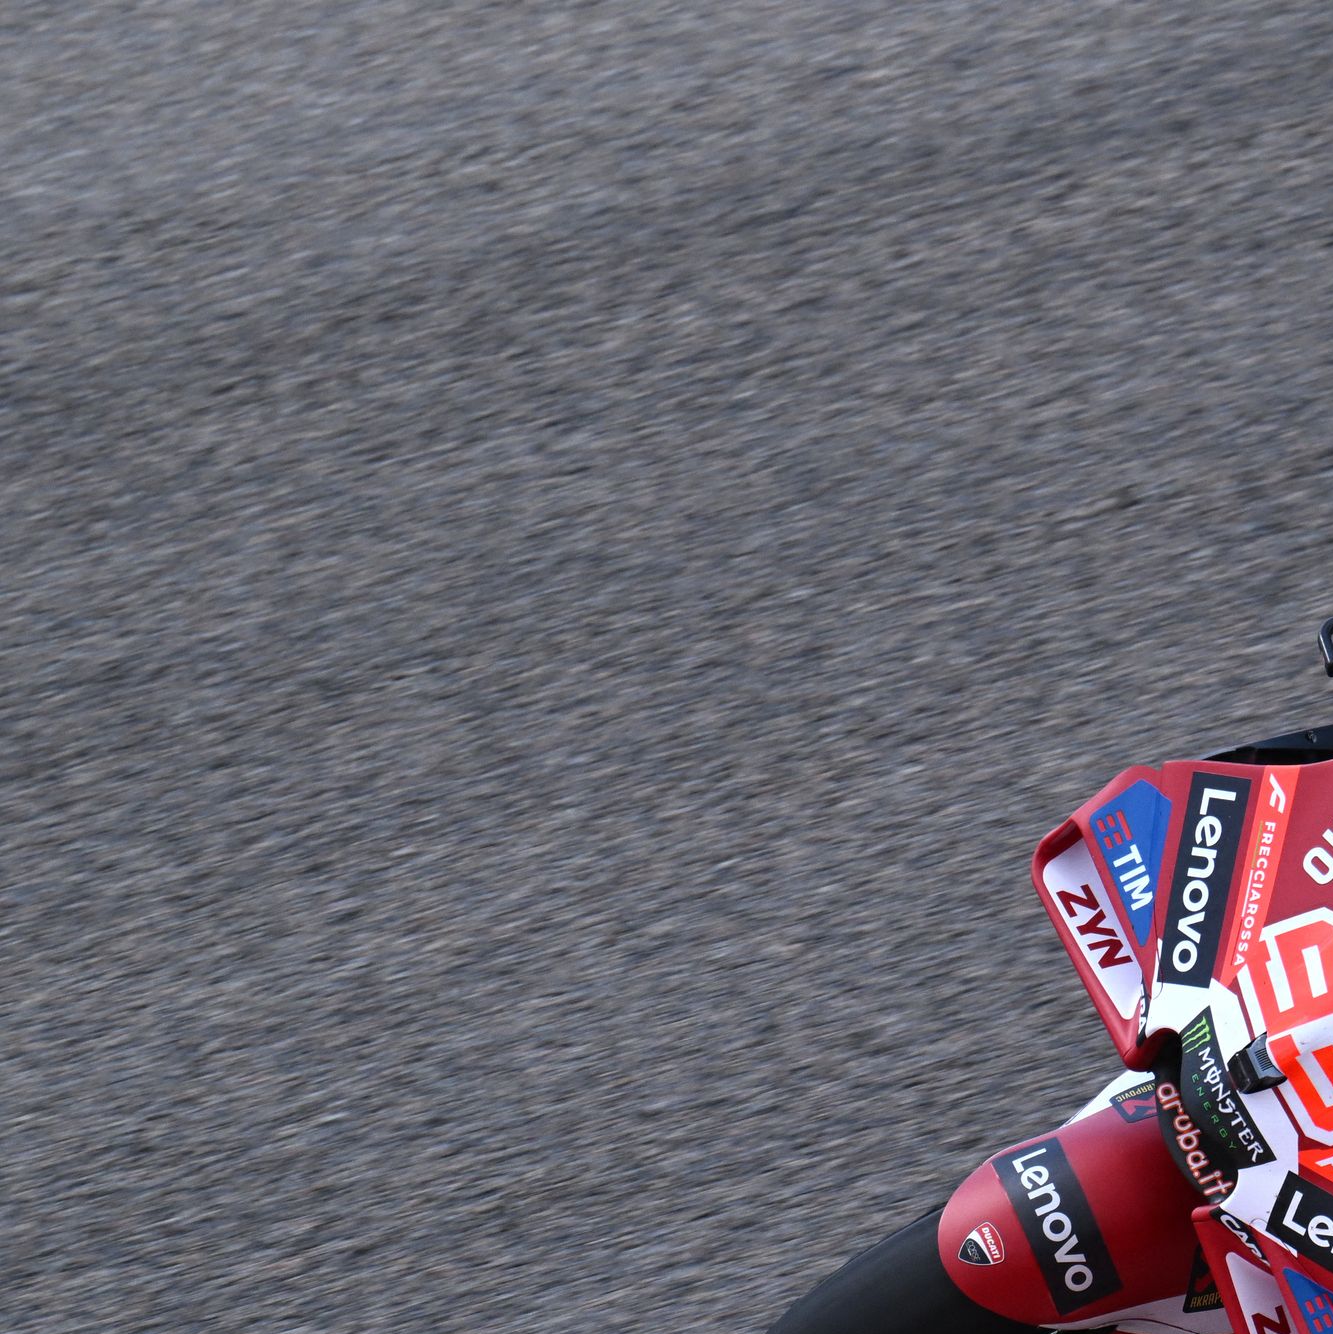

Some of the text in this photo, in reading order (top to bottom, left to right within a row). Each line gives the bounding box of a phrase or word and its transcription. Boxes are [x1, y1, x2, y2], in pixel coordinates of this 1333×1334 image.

[1056, 883, 1134, 970] ZYN
[1112, 844, 1155, 911] TIM
[1172, 786, 1237, 973] Lenovo
[1234, 821, 1276, 967] FRECCIAROSSA
[1156, 1081, 1235, 1200] aruba.it
[1190, 1073, 1237, 1150] ENERGY
[1198, 1046, 1264, 1163] MONSTER
[981, 1225, 1001, 1260] DUCATI
[1012, 1147, 1094, 1293] Lenovo
